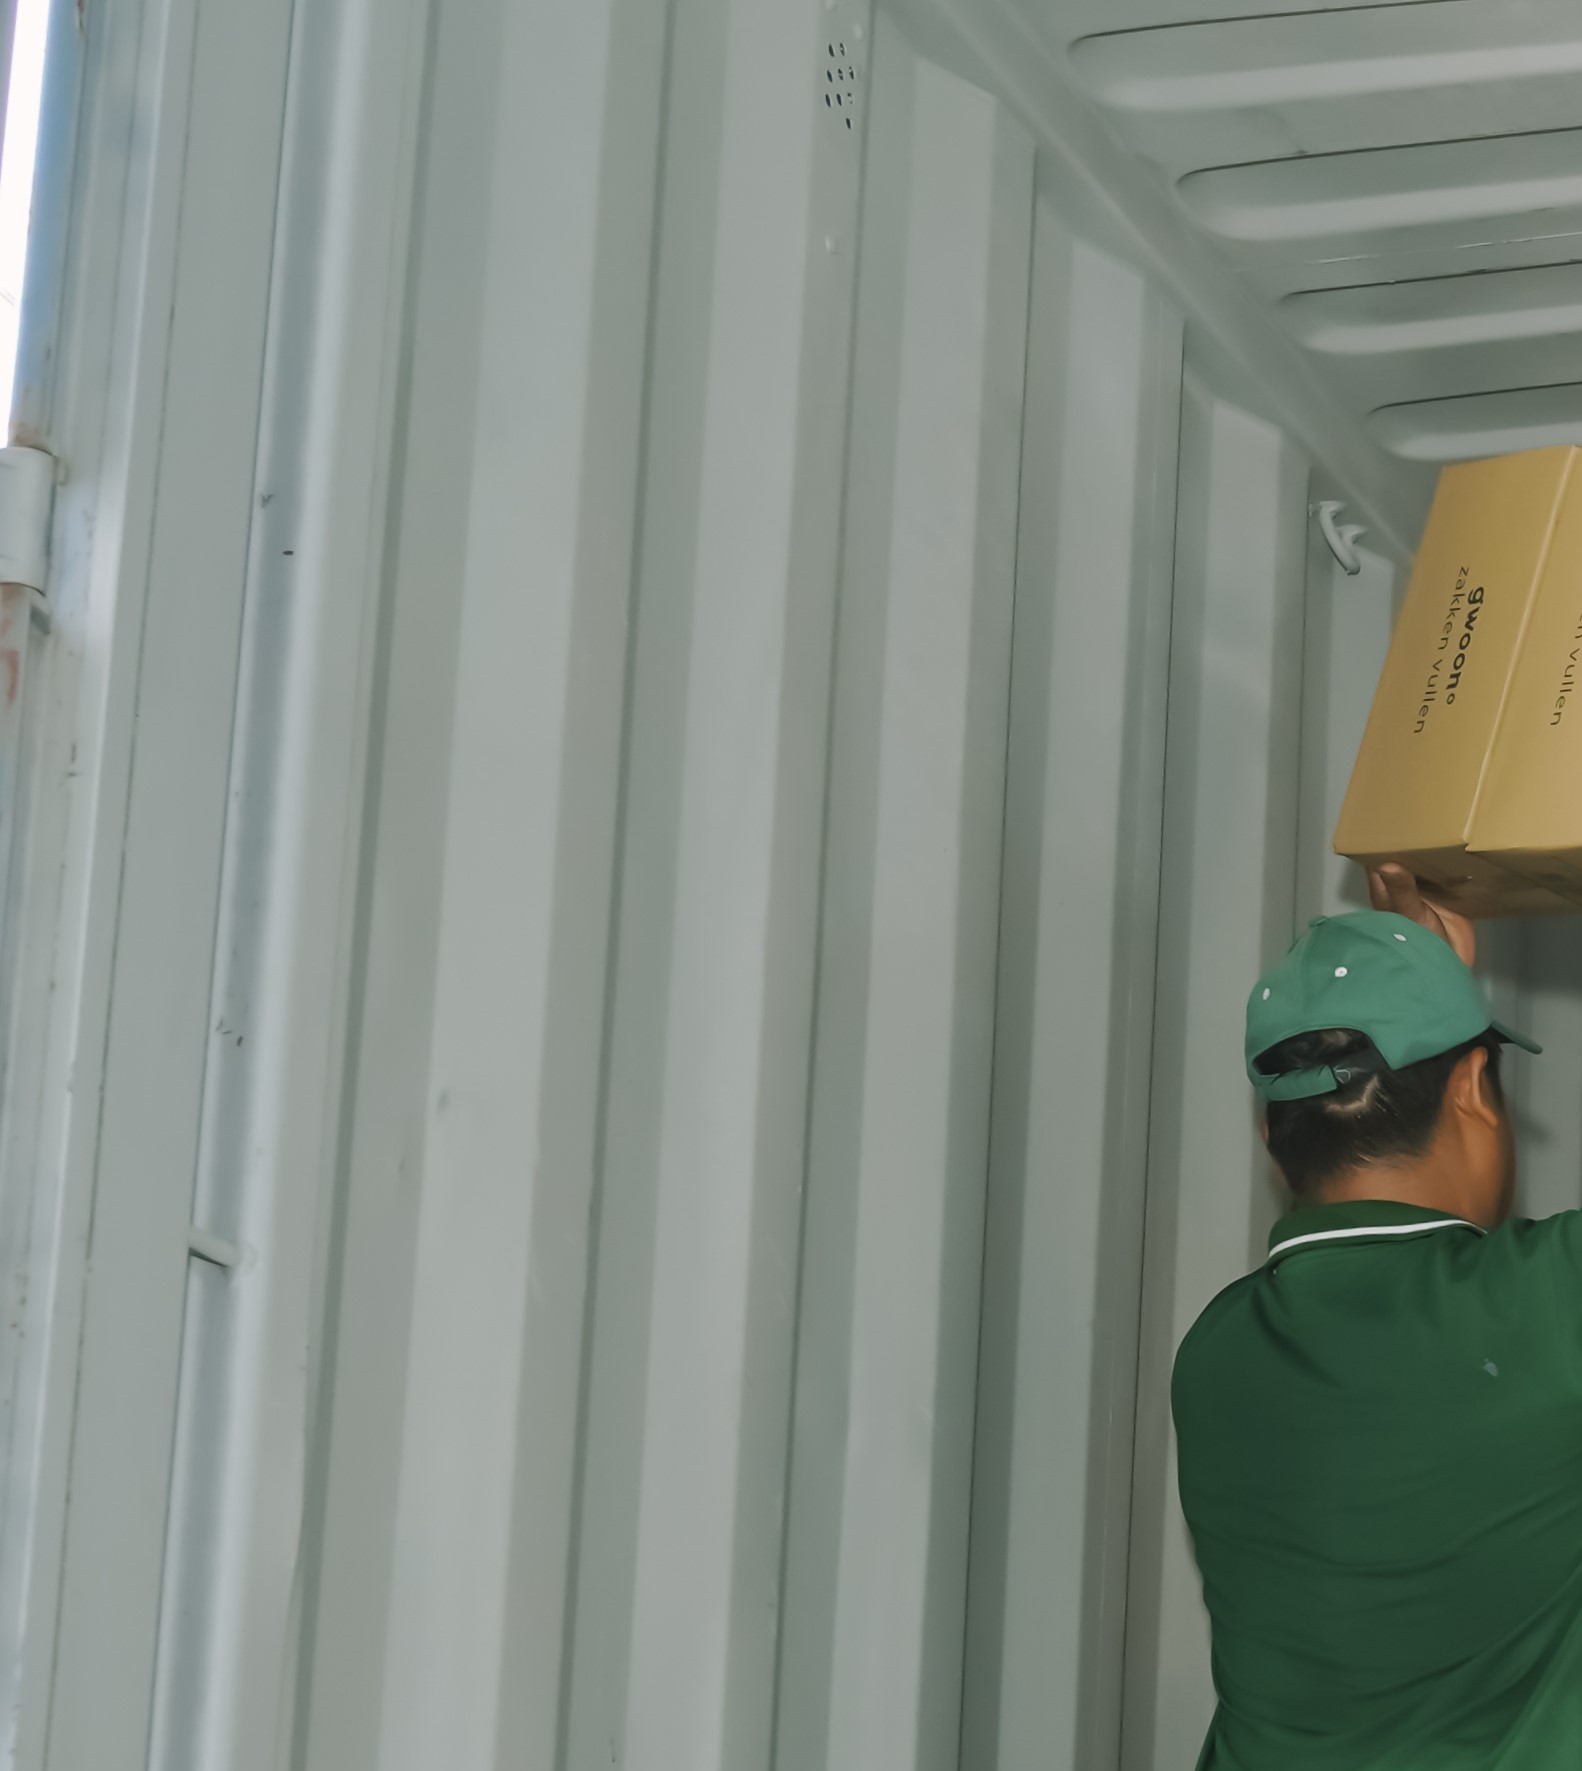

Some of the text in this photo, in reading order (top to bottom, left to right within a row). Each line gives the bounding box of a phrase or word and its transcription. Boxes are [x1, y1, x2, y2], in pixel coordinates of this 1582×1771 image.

[1414, 566, 1470, 733] zakken vullen
[1550, 647, 1580, 726] vullen
